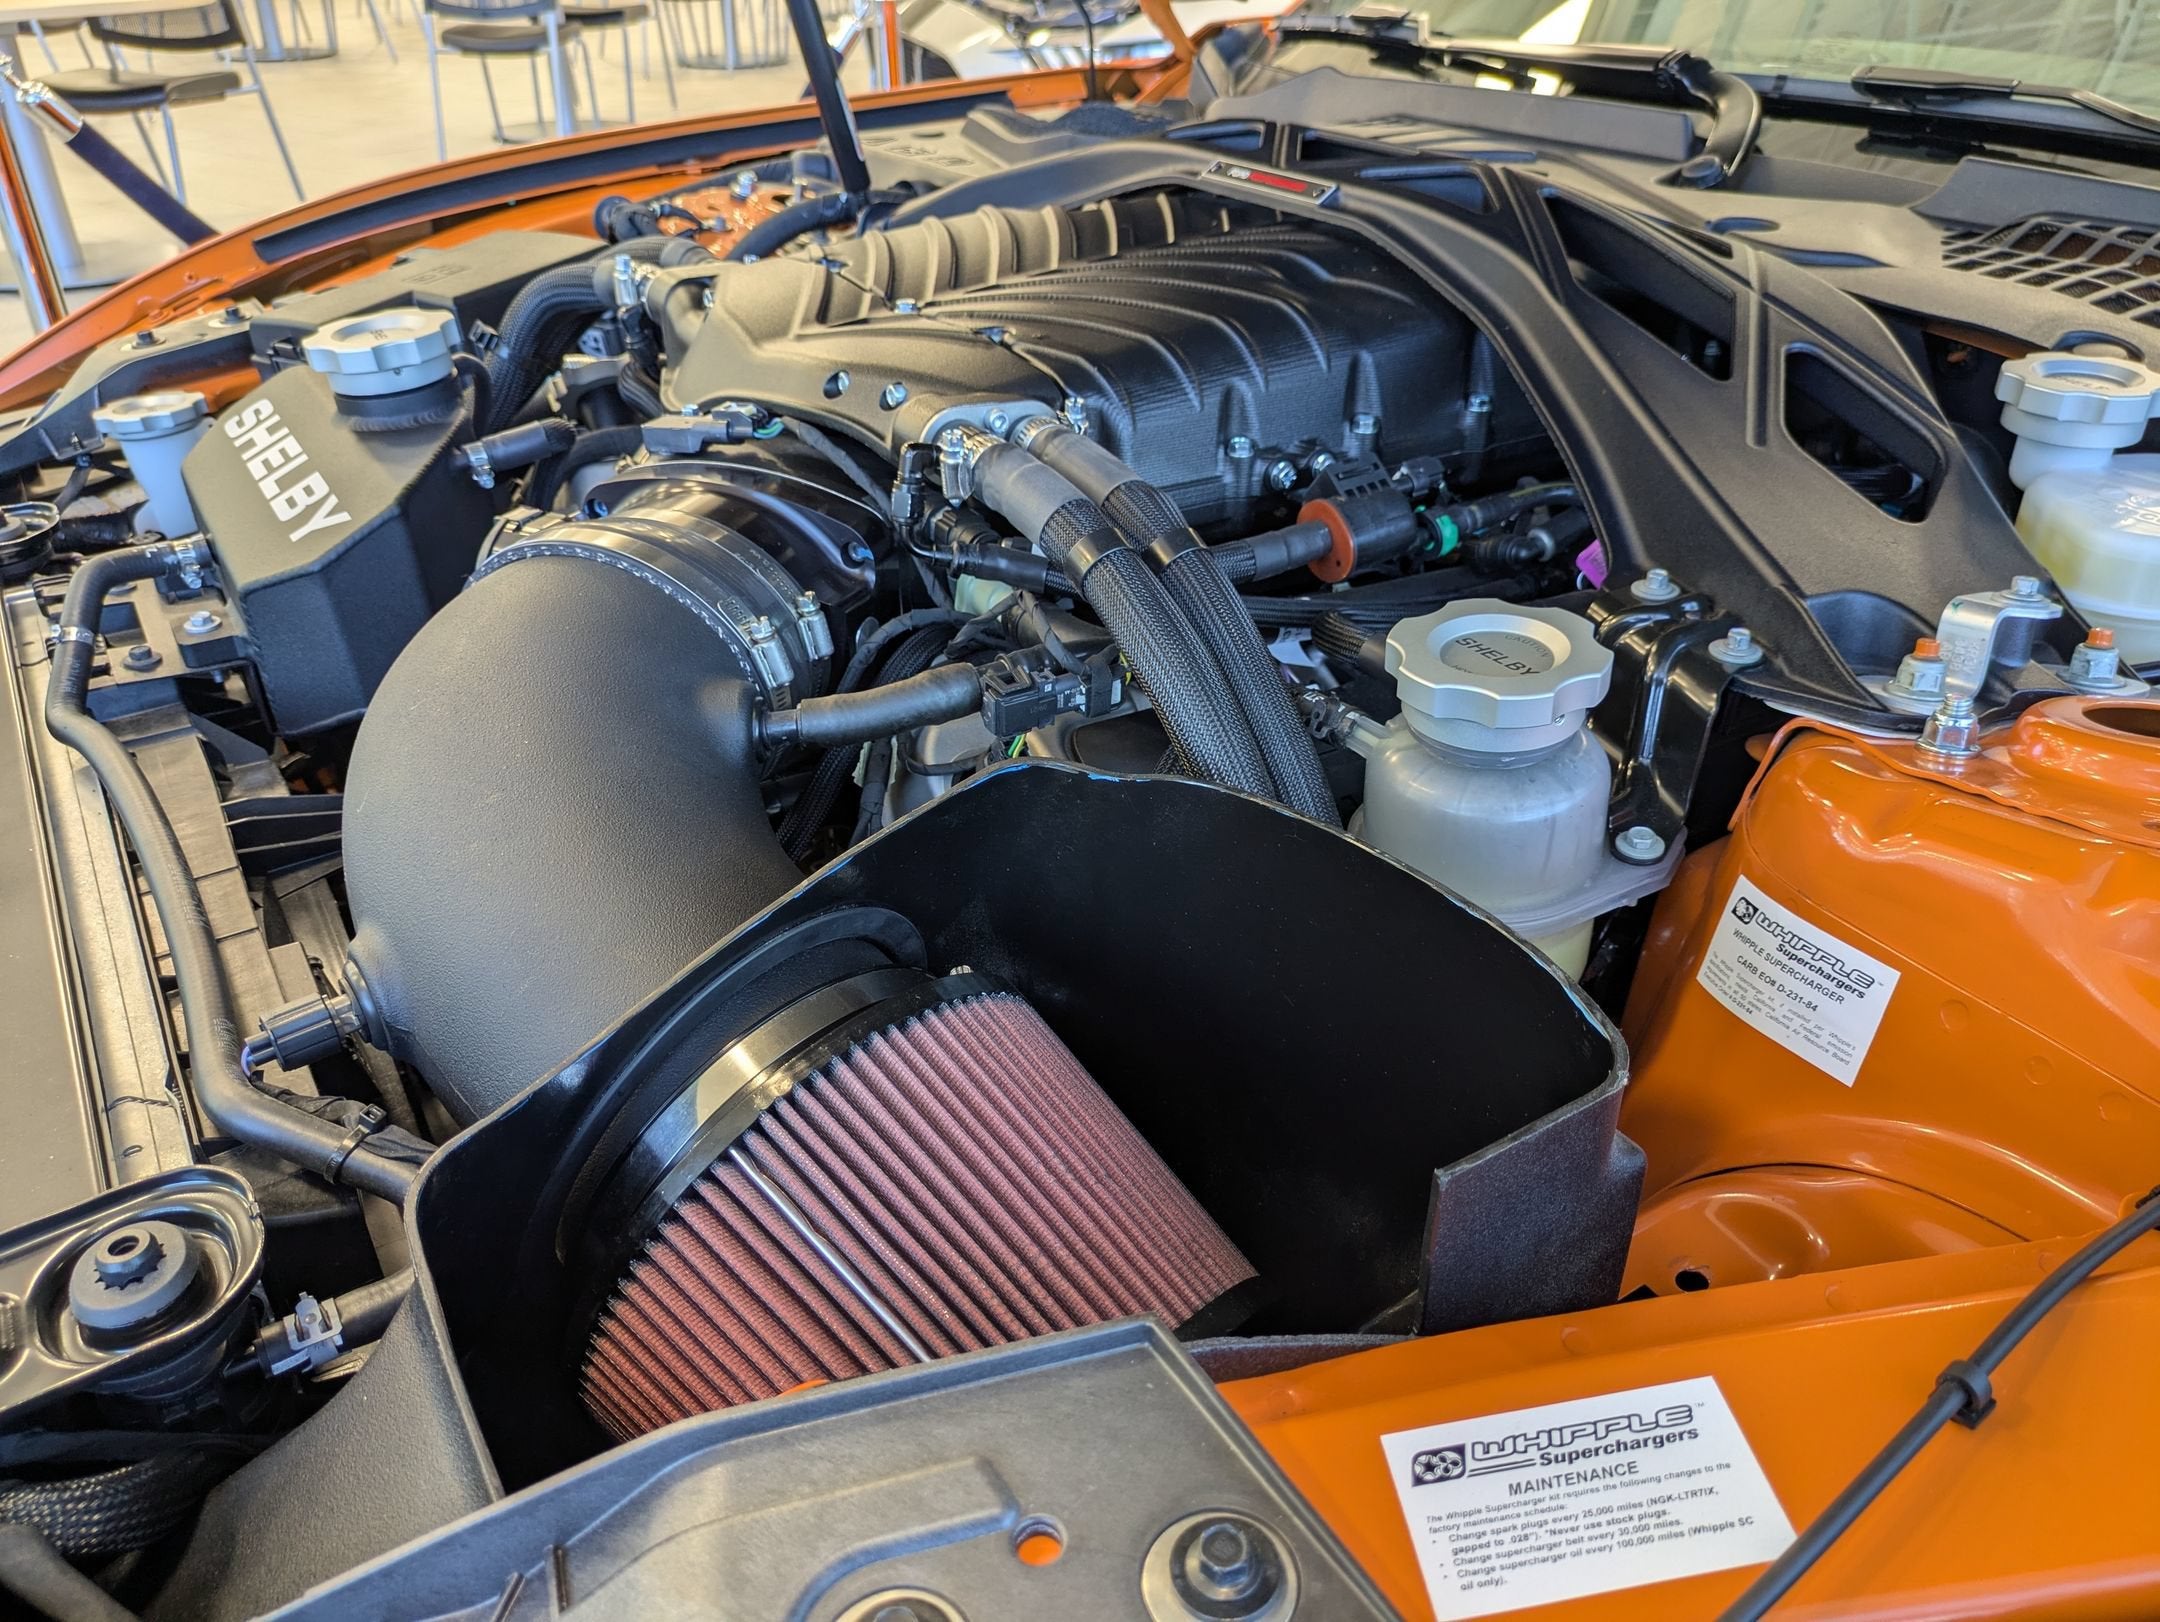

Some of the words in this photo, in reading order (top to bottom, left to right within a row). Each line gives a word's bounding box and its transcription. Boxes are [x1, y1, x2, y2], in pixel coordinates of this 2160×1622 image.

[224, 398, 352, 543] SHELBY
[1455, 637, 1540, 676] SHELBY
[1732, 928, 1765, 957] WHIPPLE
[1764, 952, 1845, 1005] SUPERCHARGER
[1755, 911, 1875, 990] WHIPPLE
[1776, 943, 1866, 999] Superchargers
[1736, 955, 1758, 976] CARB
[1758, 971, 1777, 987] EO#
[1776, 983, 1819, 1012] D-231-84
[1471, 1404, 1693, 1461] WHIPPLE
[1540, 1427, 1699, 1466] Superchargers
[1426, 1515, 1443, 1523] The
[1446, 1507, 1483, 1520] Whipple
[1485, 1496, 1546, 1512] Supercharger
[1549, 1492, 1561, 1501] kit
[1563, 1486, 1600, 1500] requires
[1603, 1482, 1617, 1492] the
[1620, 1475, 1662, 1488] following
[1664, 1467, 1702, 1480] changes
[1704, 1464, 1714, 1473] to
[1716, 1461, 1731, 1471] the
[1508, 1460, 1639, 1496] MAINTENANCE
[1428, 1522, 1461, 1534] factory
[1463, 1512, 1521, 1528] maintenance
[1523, 1503, 1568, 1517] schedule:
[1449, 1529, 1487, 1543] Change
[1490, 1522, 1519, 1537] spark
[1521, 1517, 1549, 1531] plugs
[1551, 1512, 1579, 1524] every
[1582, 1505, 1614, 1519] 25,000
[1616, 1498, 1644, 1512] miles
[1452, 1541, 1491, 1557] gapped
[1494, 1537, 1505, 1548] to
[1583, 1520, 1604, 1531] use
[1606, 1513, 1634, 1526] stock
[1638, 1508, 1671, 1522] plugs.
[1453, 1553, 1492, 1567] Change
[1495, 1540, 1562, 1560] supercharger
[1565, 1534, 1584, 1546] belt
[1587, 1530, 1615, 1543] every
[1618, 1523, 1650, 1537] 30,000
[1653, 1519, 1683, 1531] miles.
[1457, 1565, 1496, 1578] Change
[1500, 1551, 1567, 1571] supercharger
[1570, 1548, 1583, 1558] oil
[1585, 1542, 1613, 1554] every
[1616, 1534, 1655, 1550] 100,000
[1658, 1530, 1685, 1542] miles
[1688, 1520, 1735, 1537] (Whipple
[1737, 1516, 1754, 1527] SC
[1460, 1580, 1473, 1591] oil
[1477, 1576, 1508, 1588] only).
